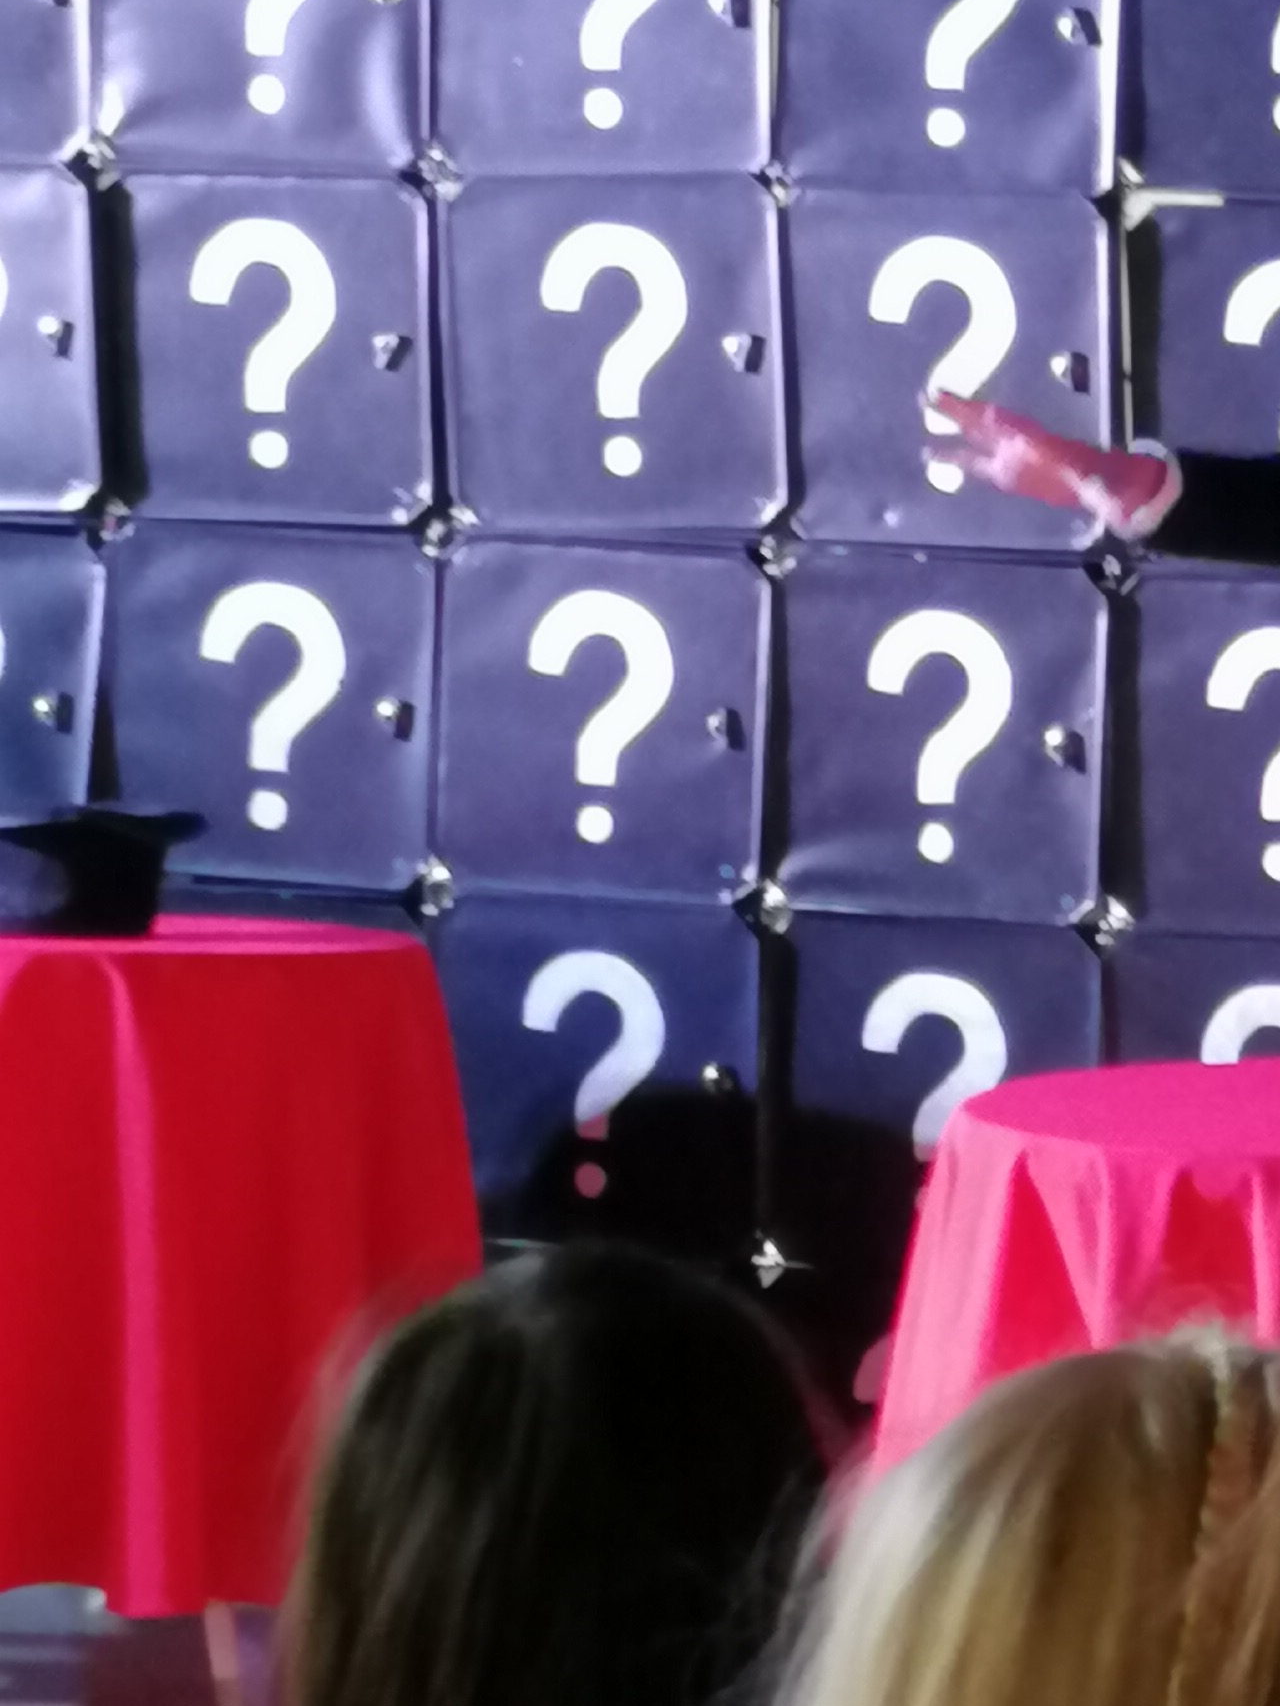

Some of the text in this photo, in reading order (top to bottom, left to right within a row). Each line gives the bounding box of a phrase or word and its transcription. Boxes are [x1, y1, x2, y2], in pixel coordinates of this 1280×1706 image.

[189, 218, 336, 468] ?
[540, 222, 687, 476] ?
[199, 580, 346, 831] ?
[528, 589, 675, 844] ?
[867, 609, 1013, 863] ?
[522, 950, 666, 1199] ?
